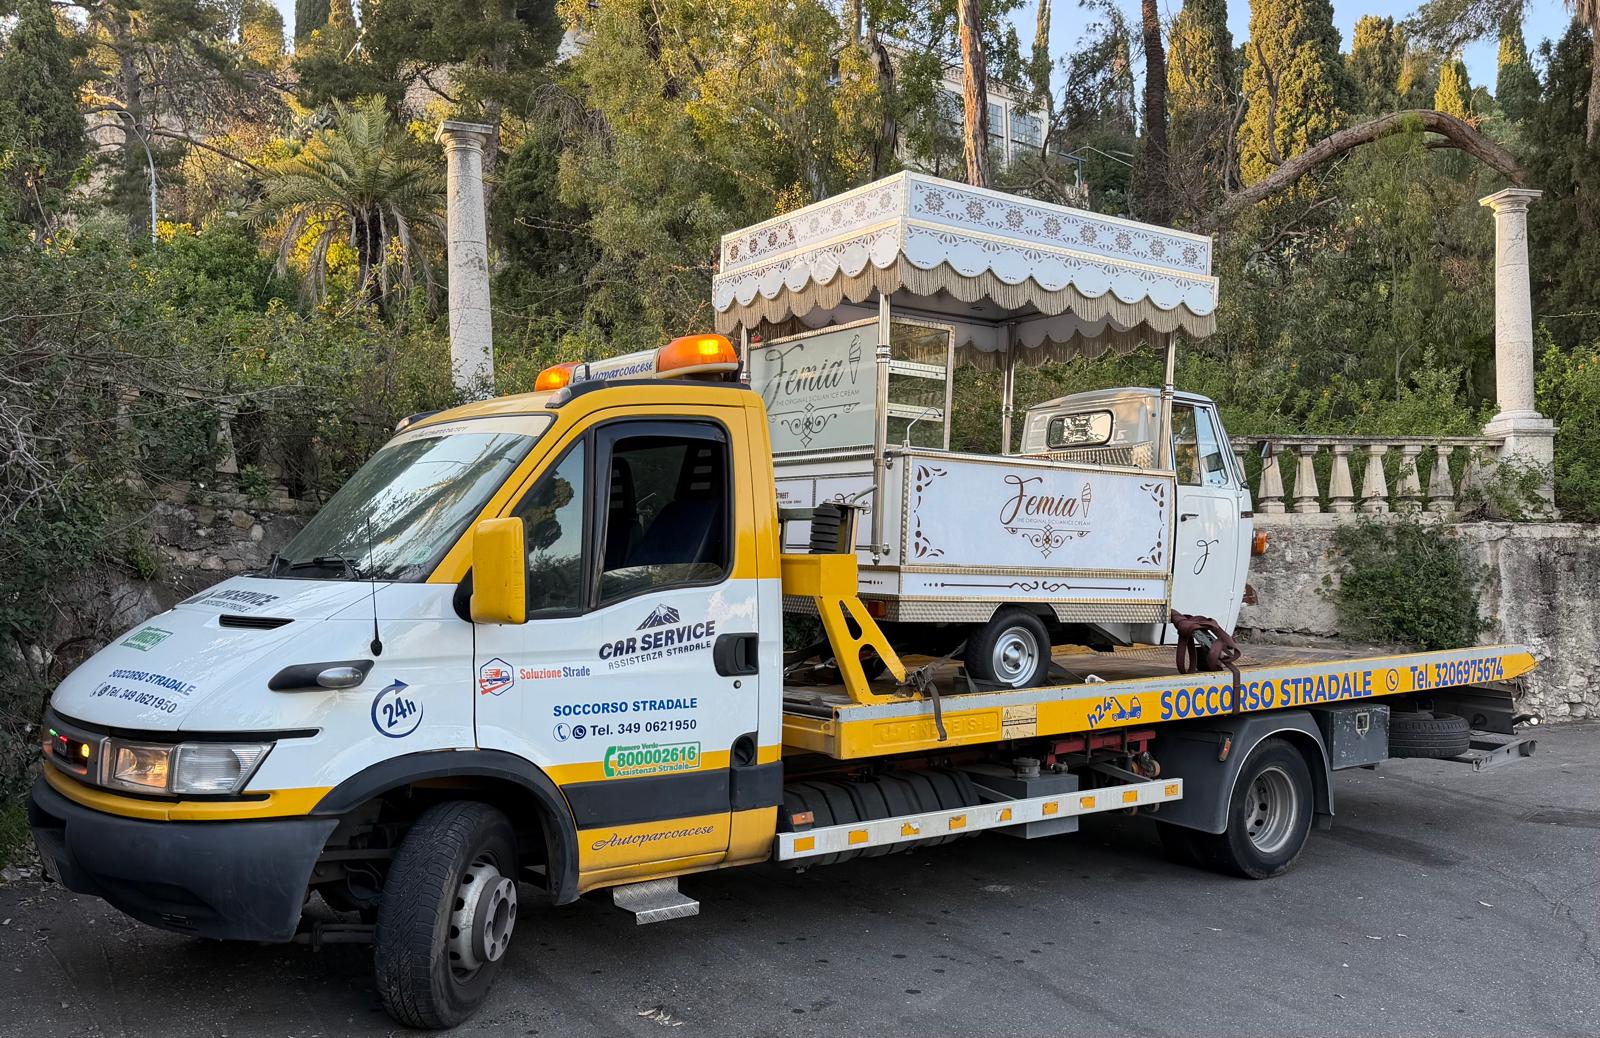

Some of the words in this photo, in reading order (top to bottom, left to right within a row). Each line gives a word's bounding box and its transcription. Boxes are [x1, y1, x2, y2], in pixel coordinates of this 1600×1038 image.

[575, 361, 653, 382] utoparcoacese
[1000, 474, 1080, 525] Femia
[599, 637, 637, 660] CAR
[640, 620, 716, 652] SERVICE
[608, 650, 663, 670] ASSISTENZA
[666, 640, 711, 656] STRADALE
[519, 667, 562, 680] Soluzione
[562, 665, 591, 678] Strade
[1410, 666, 1432, 690] Tel.
[1434, 657, 1504, 687] 3206975674
[145, 674, 196, 696] STRADALE
[1160, 680, 1275, 720] SOCCORSO
[1279, 671, 1372, 707] STRADALE
[106, 686, 122, 697] Tel.
[119, 688, 137, 701] 349
[134, 692, 178, 714] 0621950
[382, 696, 417, 728] 24h
[553, 701, 629, 717] SOCCORSO
[632, 697, 698, 712] STRADALE
[590, 724, 614, 737] Tel.
[617, 722, 641, 734] 349
[645, 719, 697, 733] 0621950
[617, 743, 641, 752] Numero
[641, 742, 659, 750] Verde
[617, 745, 697, 768] 800002616
[615, 766, 657, 777] Assistenza
[658, 762, 690, 773] Stradale
[591, 825, 714, 851] Autoparcoacese
